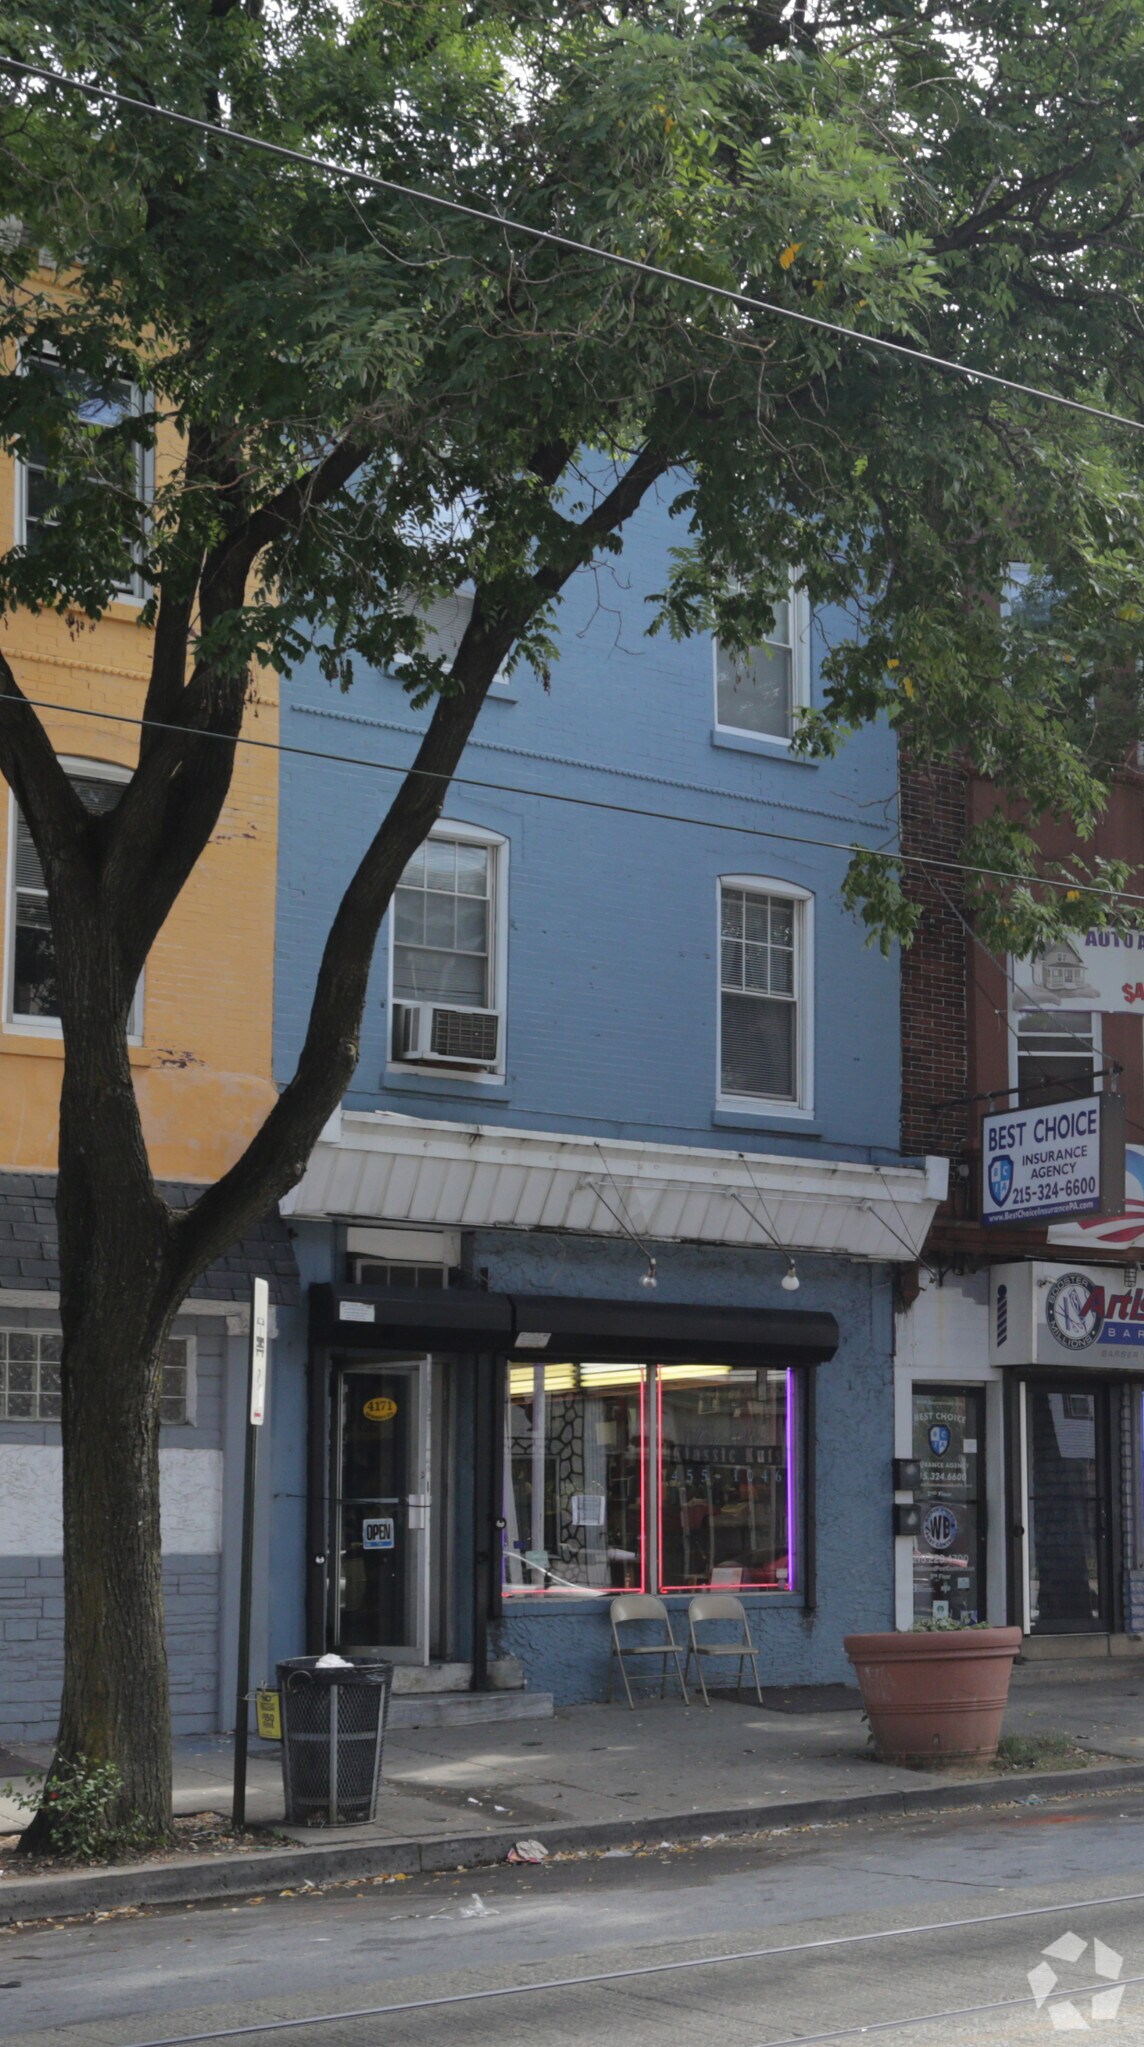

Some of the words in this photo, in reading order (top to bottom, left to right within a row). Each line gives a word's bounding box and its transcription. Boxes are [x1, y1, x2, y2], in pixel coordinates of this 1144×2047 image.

[1085, 930, 1133, 949] AUTO
[988, 1122, 1027, 1152] BEST
[1033, 1109, 1097, 1143] CHOICE
[1022, 1145, 1088, 1167] INSURANCE
[1030, 1161, 1077, 1180] AGENCY
[1012, 1175, 1096, 1205] 215-324-6600
[988, 1200, 1094, 1222] www.BestChoiceInsurancePA.com
[1048, 1276, 1088, 1304] BOOSTER
[1050, 1320, 1092, 1347] MILLIONS
[367, 1400, 392, 1412] 4171
[935, 1412, 966, 1424] CHOICE
[366, 1524, 391, 1541] OPEN
[930, 1515, 950, 1540] WB
